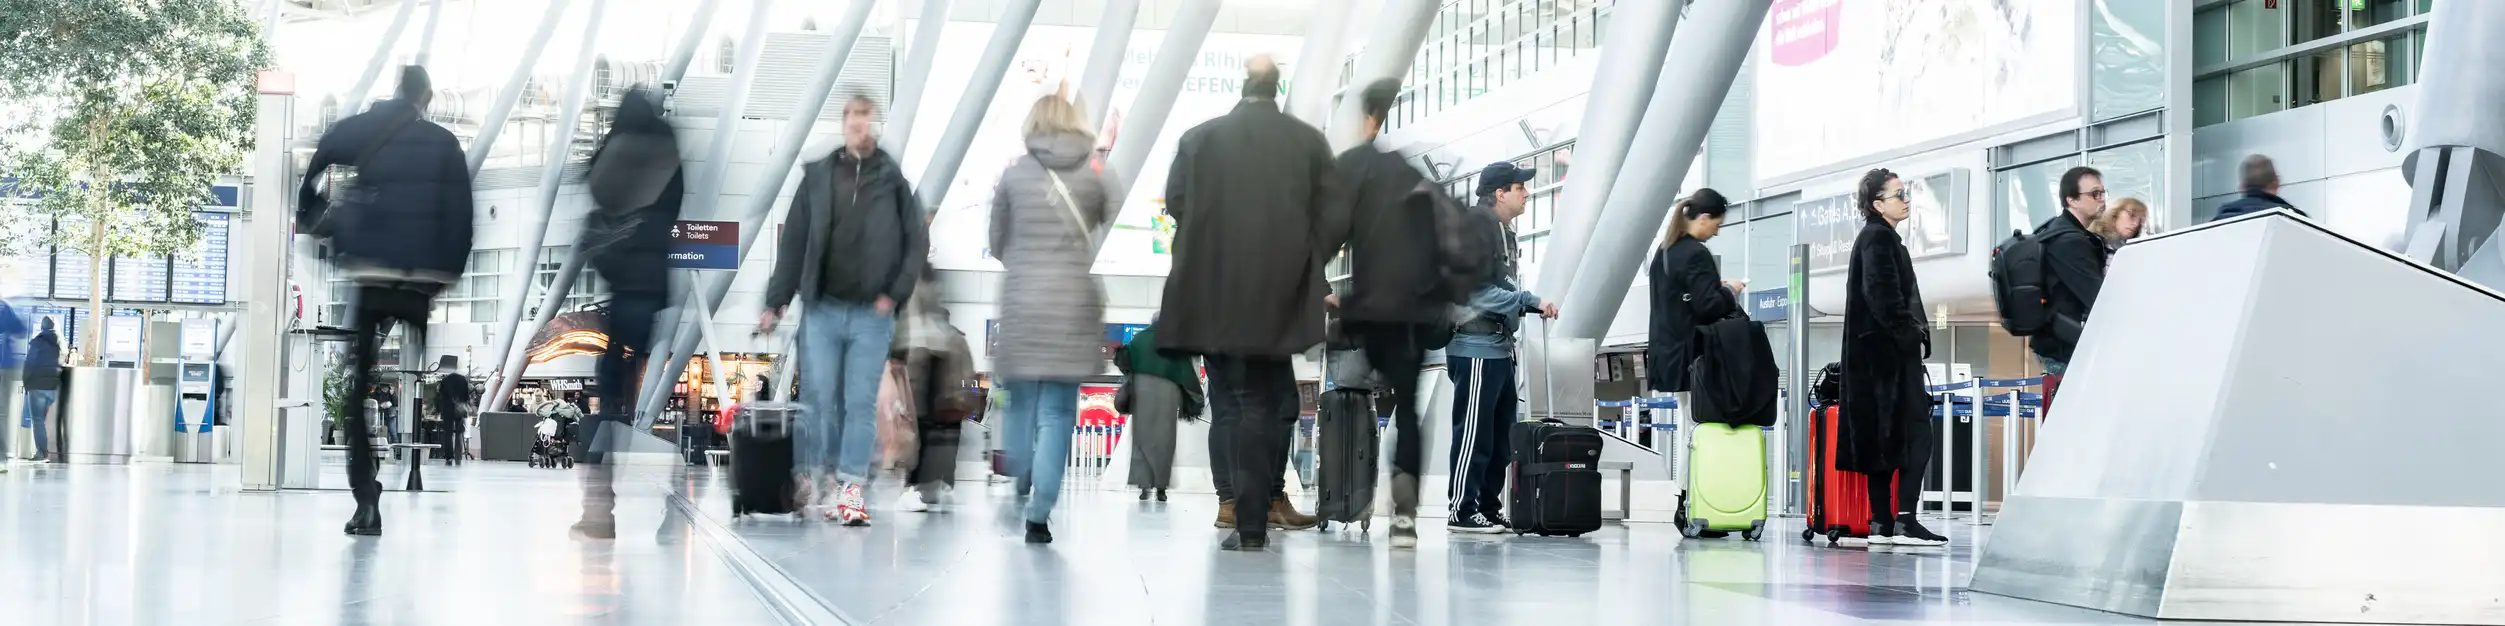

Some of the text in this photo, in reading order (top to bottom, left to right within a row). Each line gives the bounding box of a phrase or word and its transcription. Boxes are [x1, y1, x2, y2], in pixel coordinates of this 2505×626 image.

[686, 223, 718, 231] Toiletten
[686, 232, 709, 240] Toilets
[667, 252, 704, 260] ormation
[550, 379, 583, 391] WHSmith
